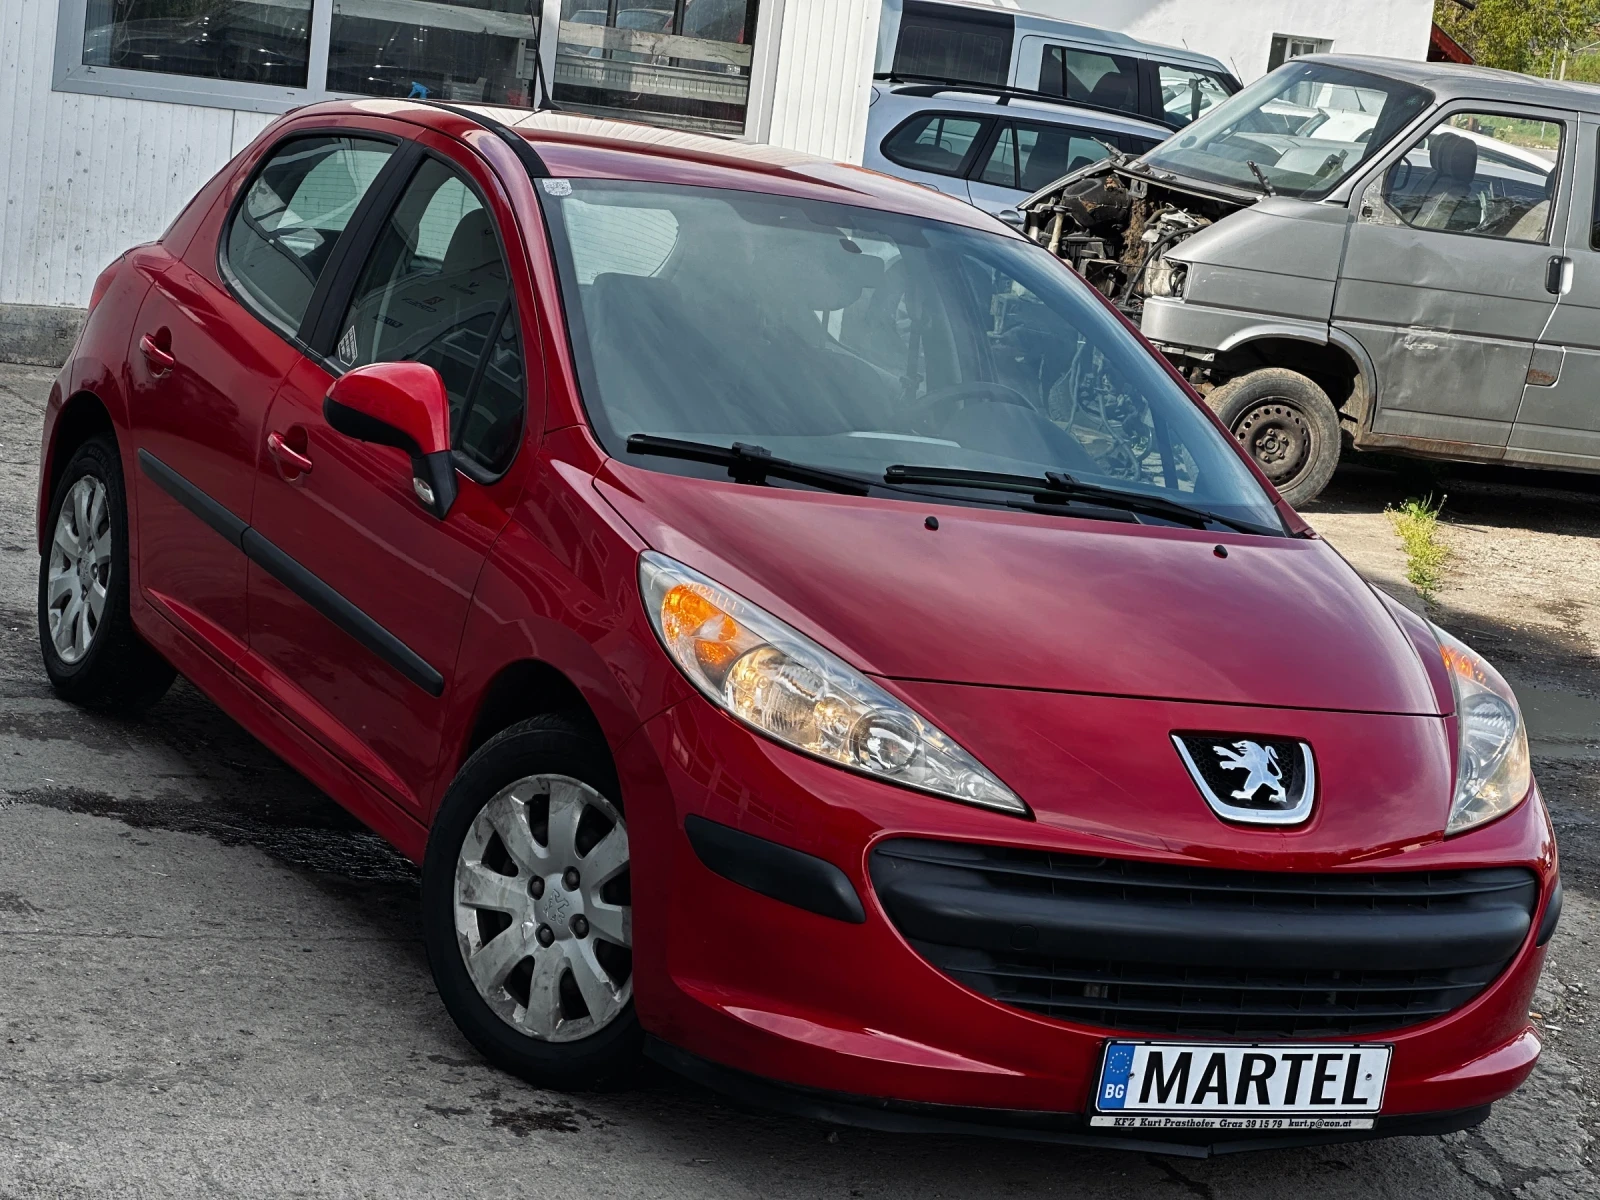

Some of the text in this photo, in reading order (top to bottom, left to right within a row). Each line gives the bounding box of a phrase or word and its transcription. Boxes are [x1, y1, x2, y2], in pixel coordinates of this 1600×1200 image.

[1138, 1051, 1369, 1106] MARTEL
[1104, 1084, 1125, 1099] BG
[1113, 1117, 1352, 1129] KFZ Kurt Prasthofer Graz 39 15 79 kurt.p@aon.at
